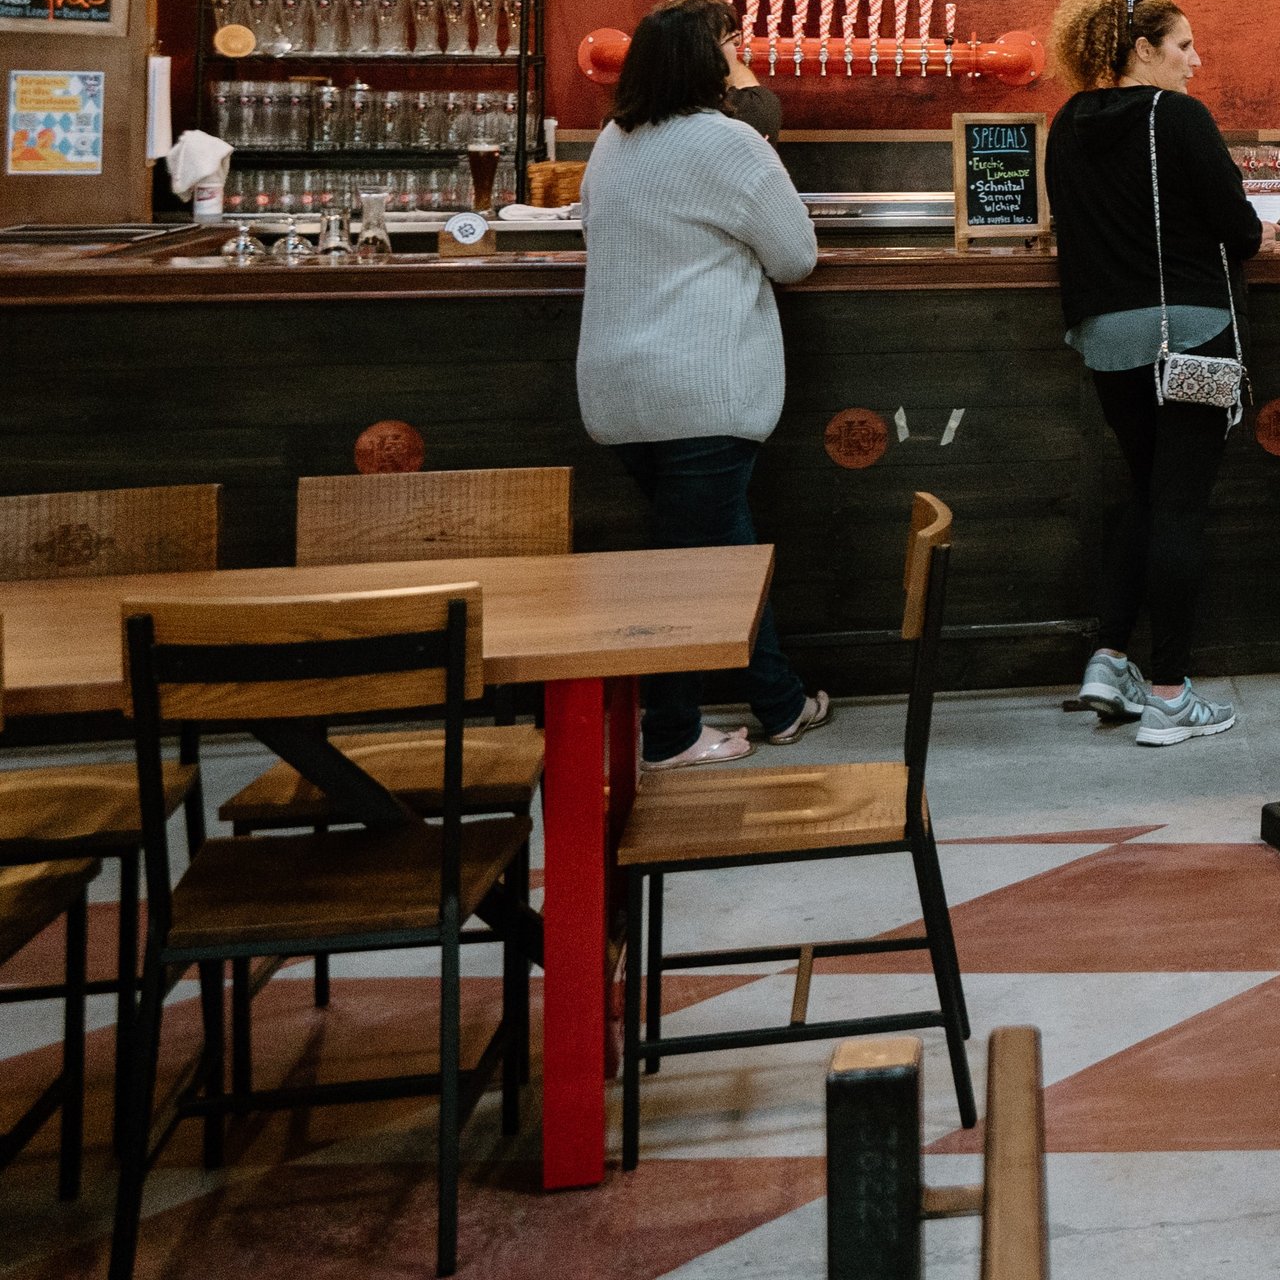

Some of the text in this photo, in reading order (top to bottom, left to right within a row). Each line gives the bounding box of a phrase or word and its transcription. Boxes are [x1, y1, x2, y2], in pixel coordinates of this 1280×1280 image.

[972, 126, 1028, 149] SPECIALS
[976, 178, 1025, 192] Schnitzel
[978, 192, 1022, 205] Sammy
